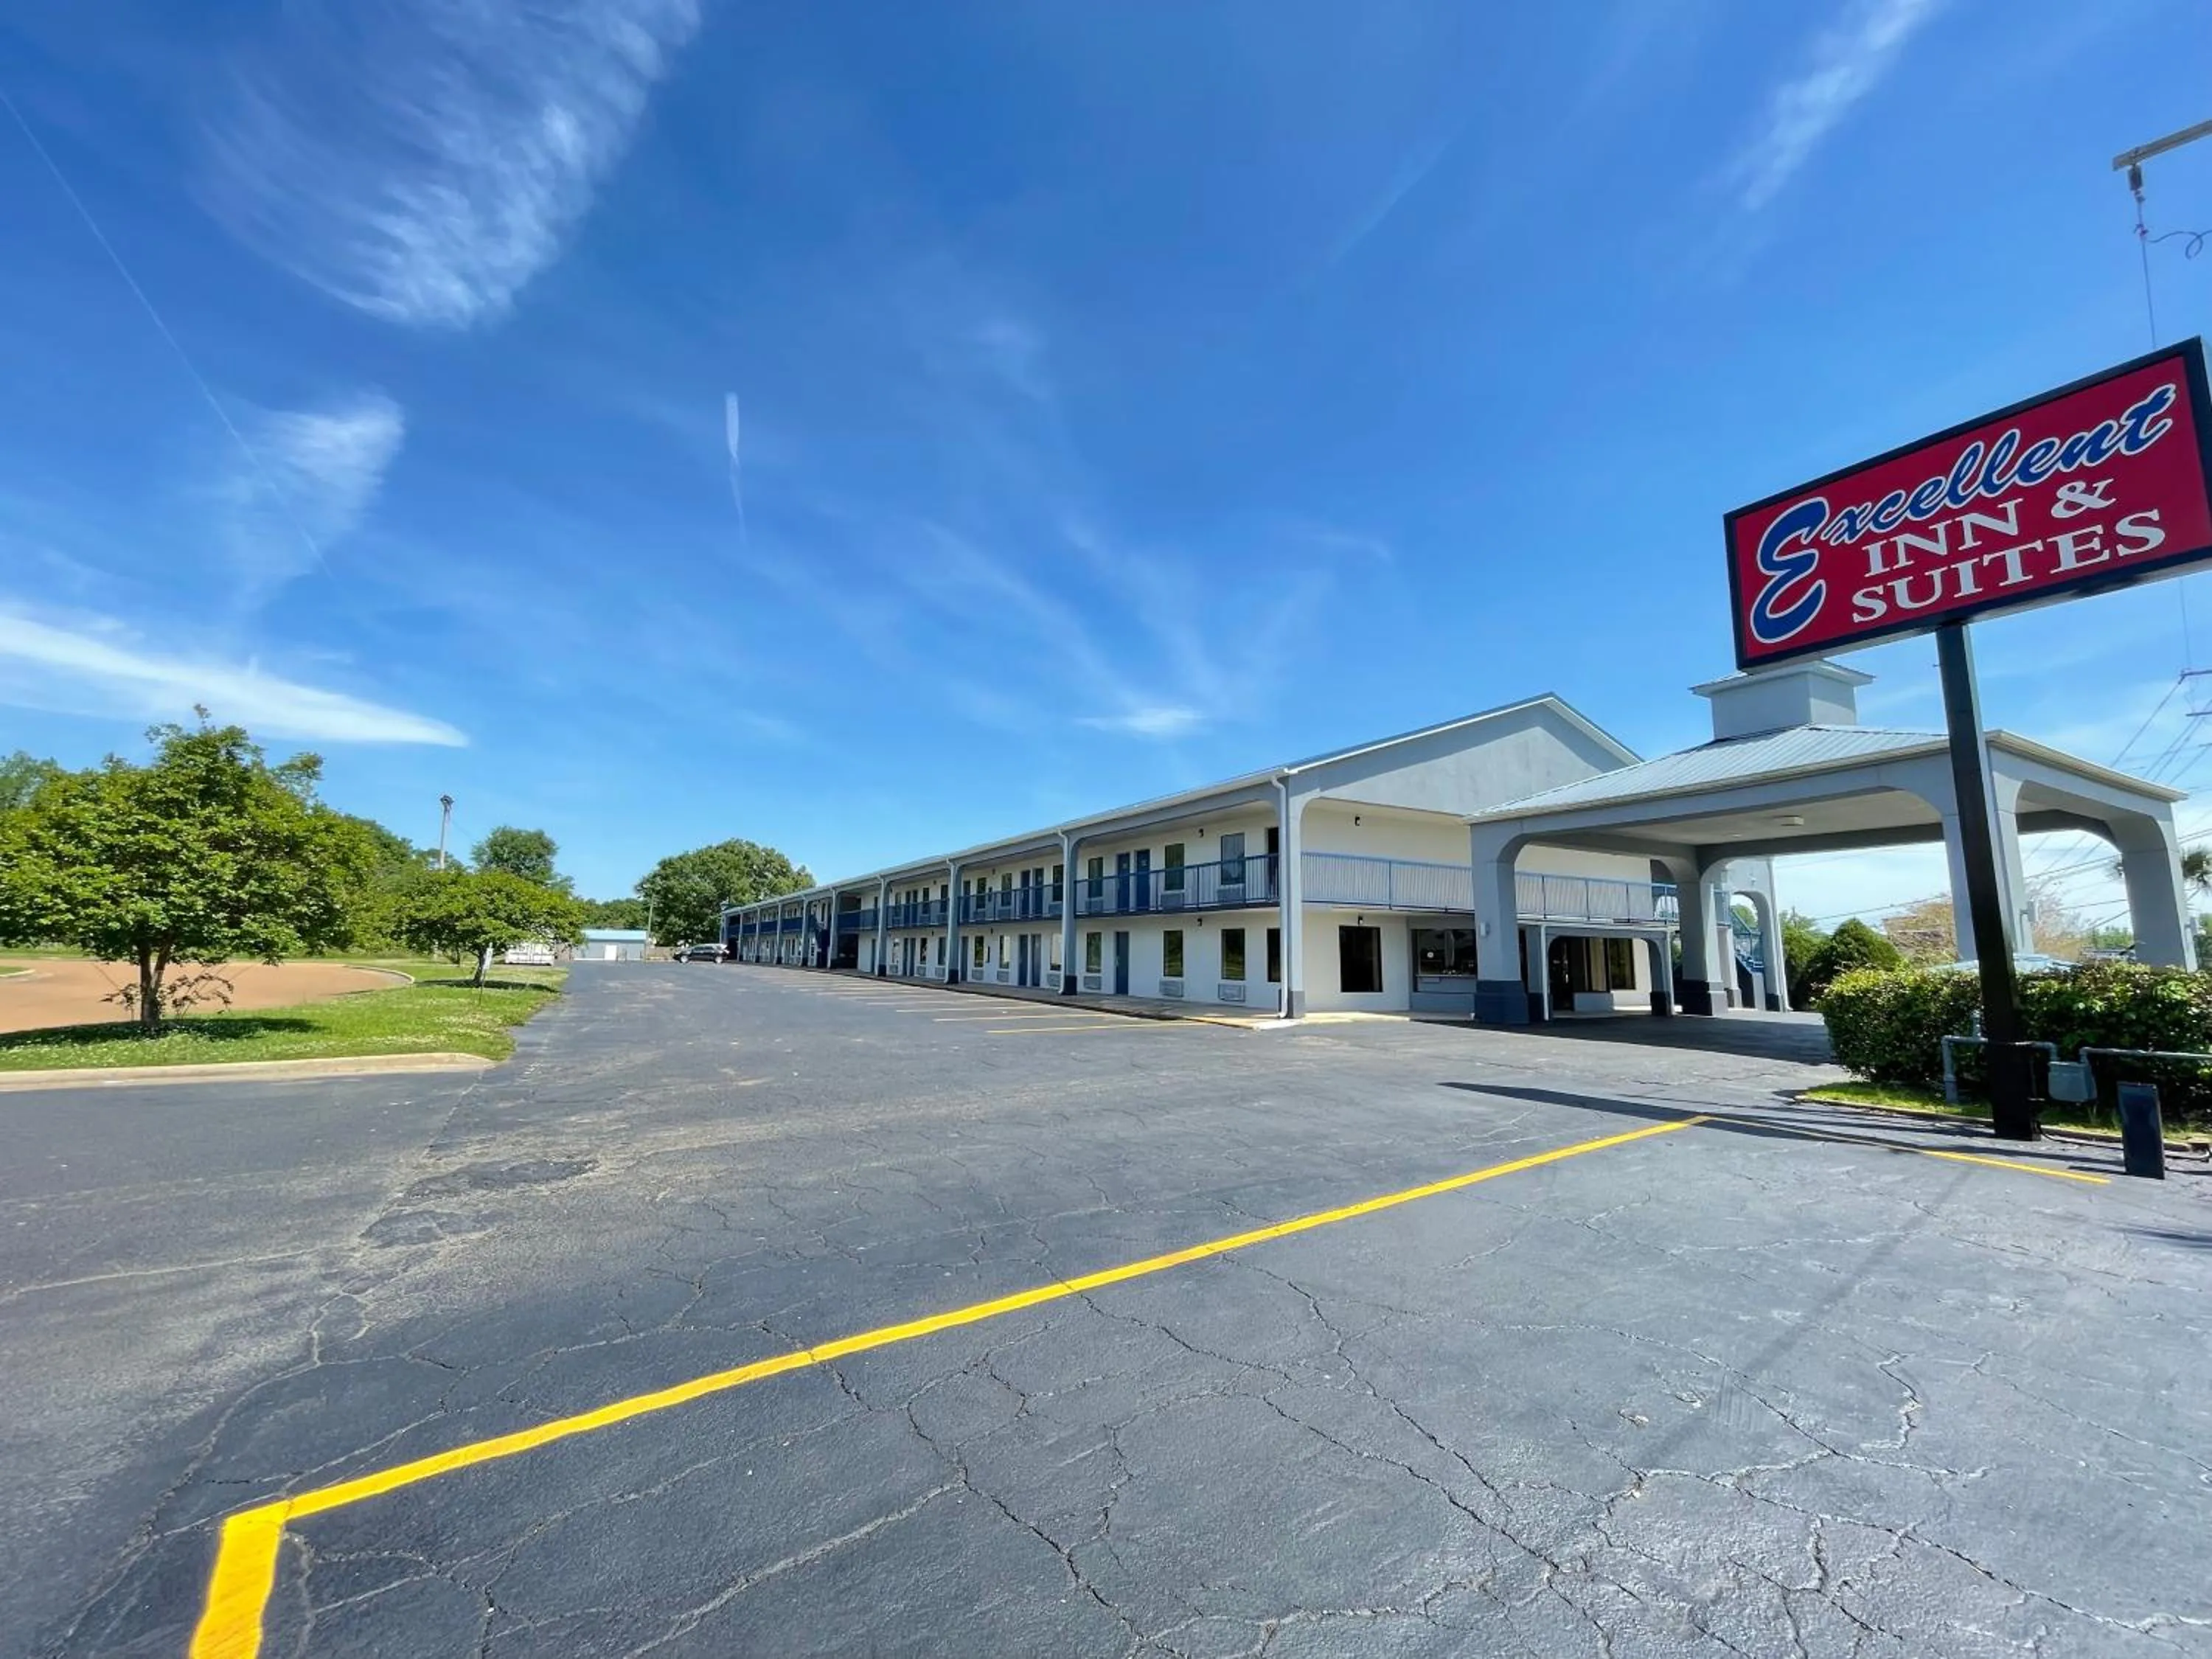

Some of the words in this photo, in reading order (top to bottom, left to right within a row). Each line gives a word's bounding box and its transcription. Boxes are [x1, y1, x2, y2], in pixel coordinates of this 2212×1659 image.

[1750, 383, 2177, 643] Excellent
[1851, 509, 2166, 623] SUITES
[1863, 498, 2023, 578] INN
[2051, 479, 2116, 518] &
